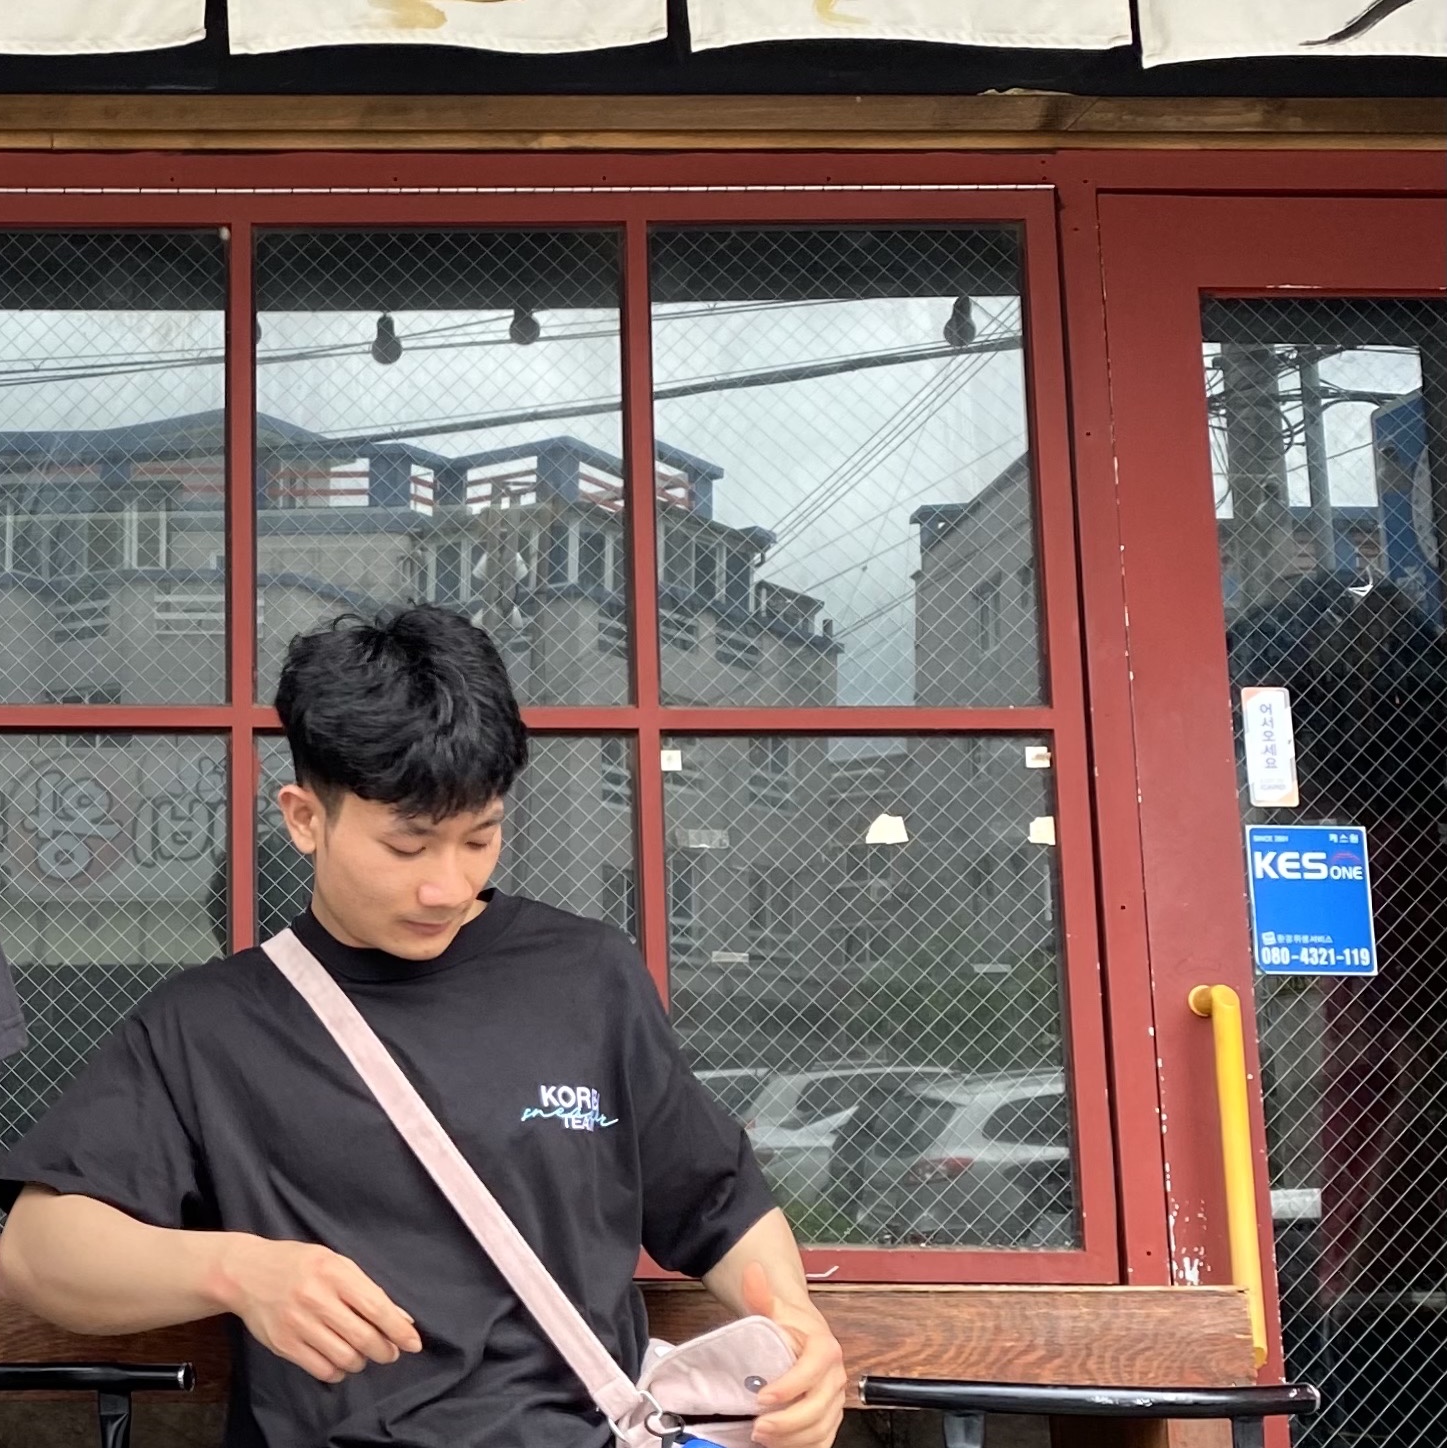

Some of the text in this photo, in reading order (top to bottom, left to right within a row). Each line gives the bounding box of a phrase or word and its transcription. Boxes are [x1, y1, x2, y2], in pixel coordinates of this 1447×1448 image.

[1259, 703, 1278, 769] 어서오세요
[1253, 851, 1365, 881] KES ONE
[1260, 946, 1372, 967] 080-4321-119
